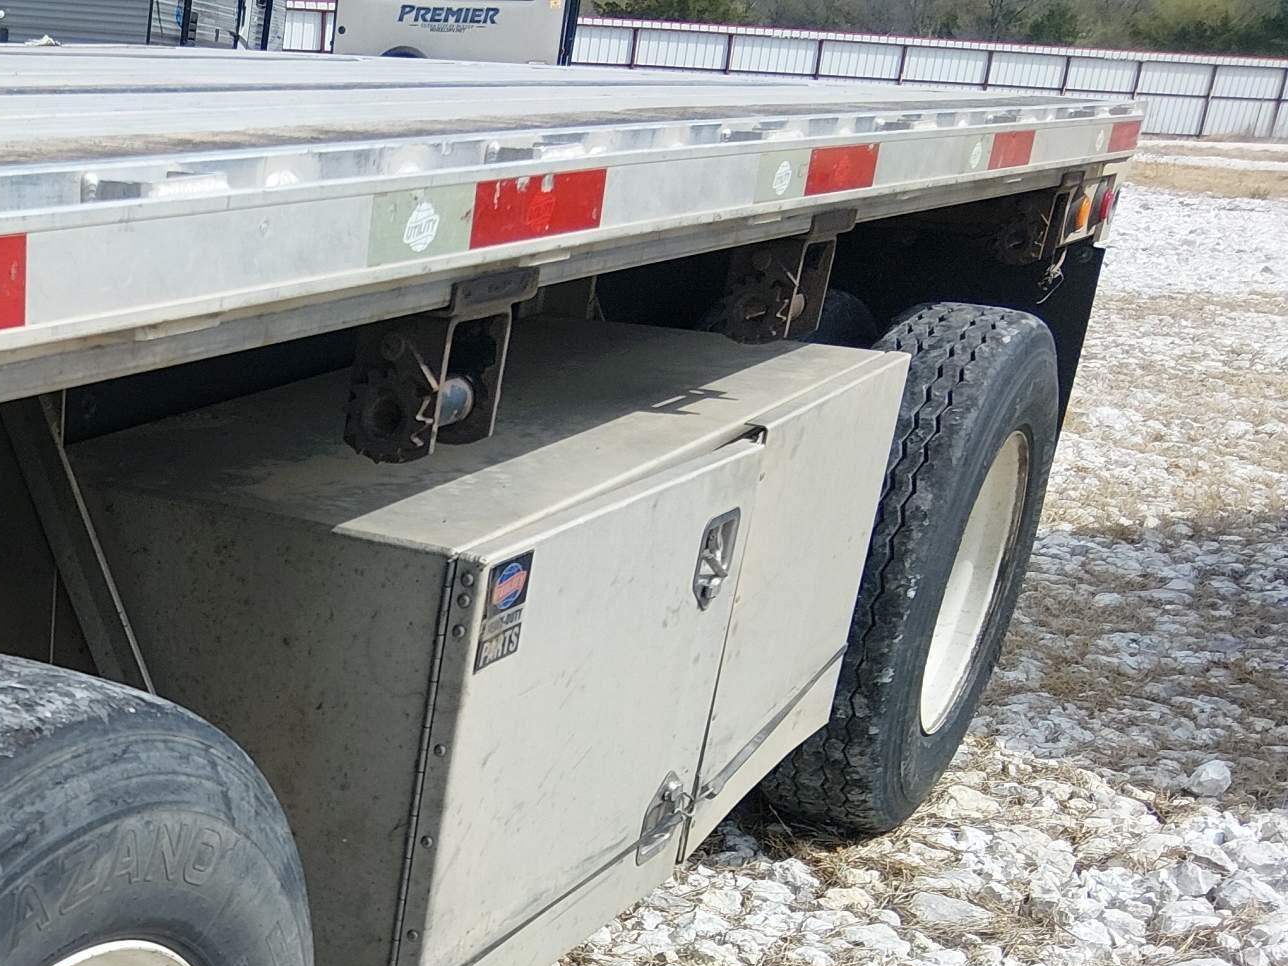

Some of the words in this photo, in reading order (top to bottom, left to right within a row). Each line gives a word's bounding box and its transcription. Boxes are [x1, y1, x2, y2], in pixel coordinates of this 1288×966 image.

[398, 5, 500, 24] PREMIER
[407, 217, 437, 239] UTILITY
[478, 626, 520, 668] PARTS
